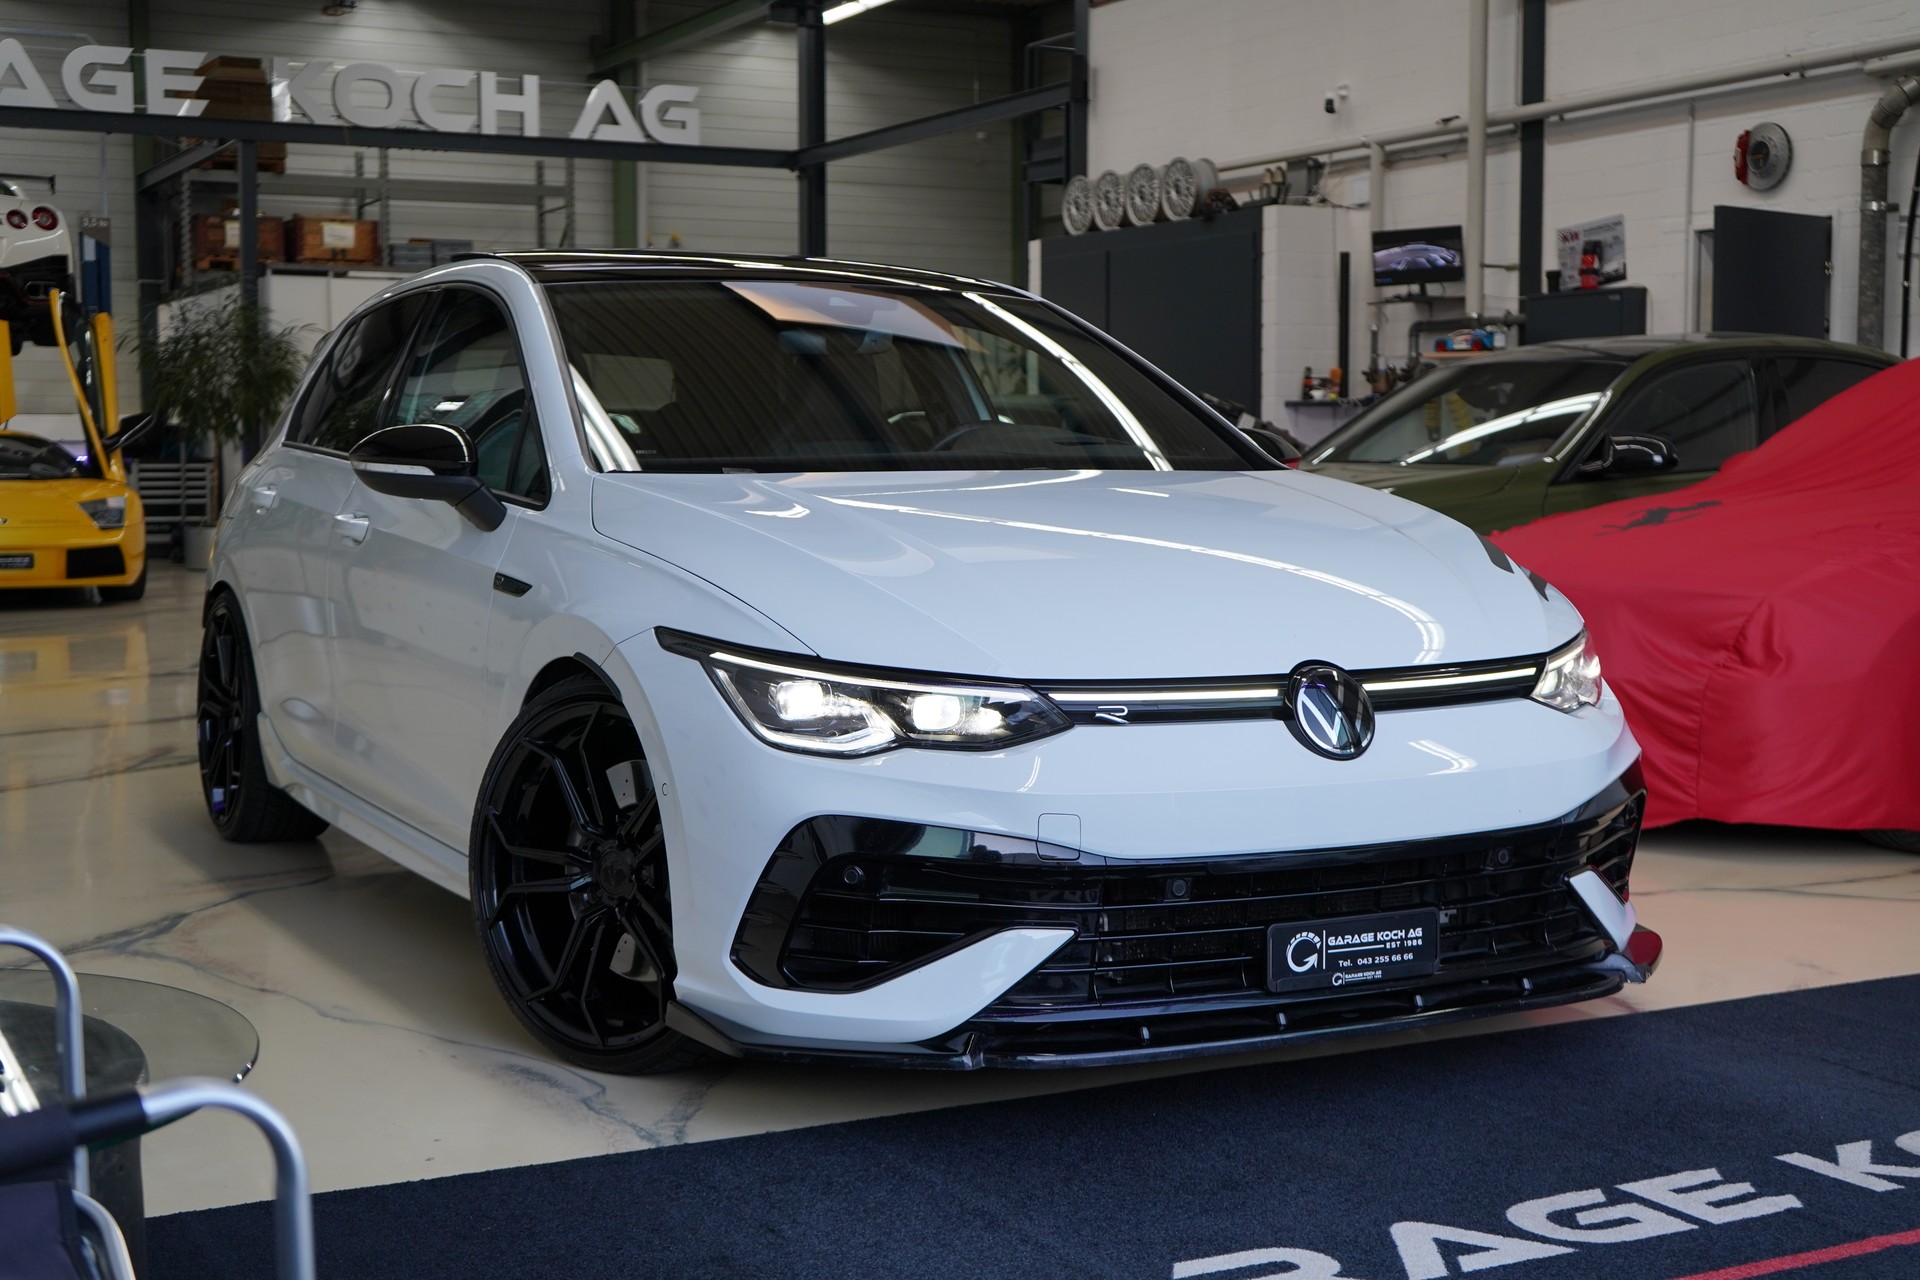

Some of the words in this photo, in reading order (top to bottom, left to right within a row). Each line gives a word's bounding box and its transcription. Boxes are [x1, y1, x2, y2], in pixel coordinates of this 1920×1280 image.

[273, 57, 540, 138] KOCH
[570, 79, 700, 146] AG
[1095, 705, 1130, 724] R
[1327, 932, 1375, 946] GARAGE
[1376, 929, 1406, 942] KOCH
[1407, 927, 1423, 939] AG
[1386, 941, 1401, 949] EST
[1338, 958, 1353, 968] Tel.
[1357, 956, 1373, 966] 043
[1374, 954, 1390, 964] 255
[1391, 953, 1402, 962] 66
[1403, 952, 1414, 961] 66
[1773, 1129, 1920, 1193] K
